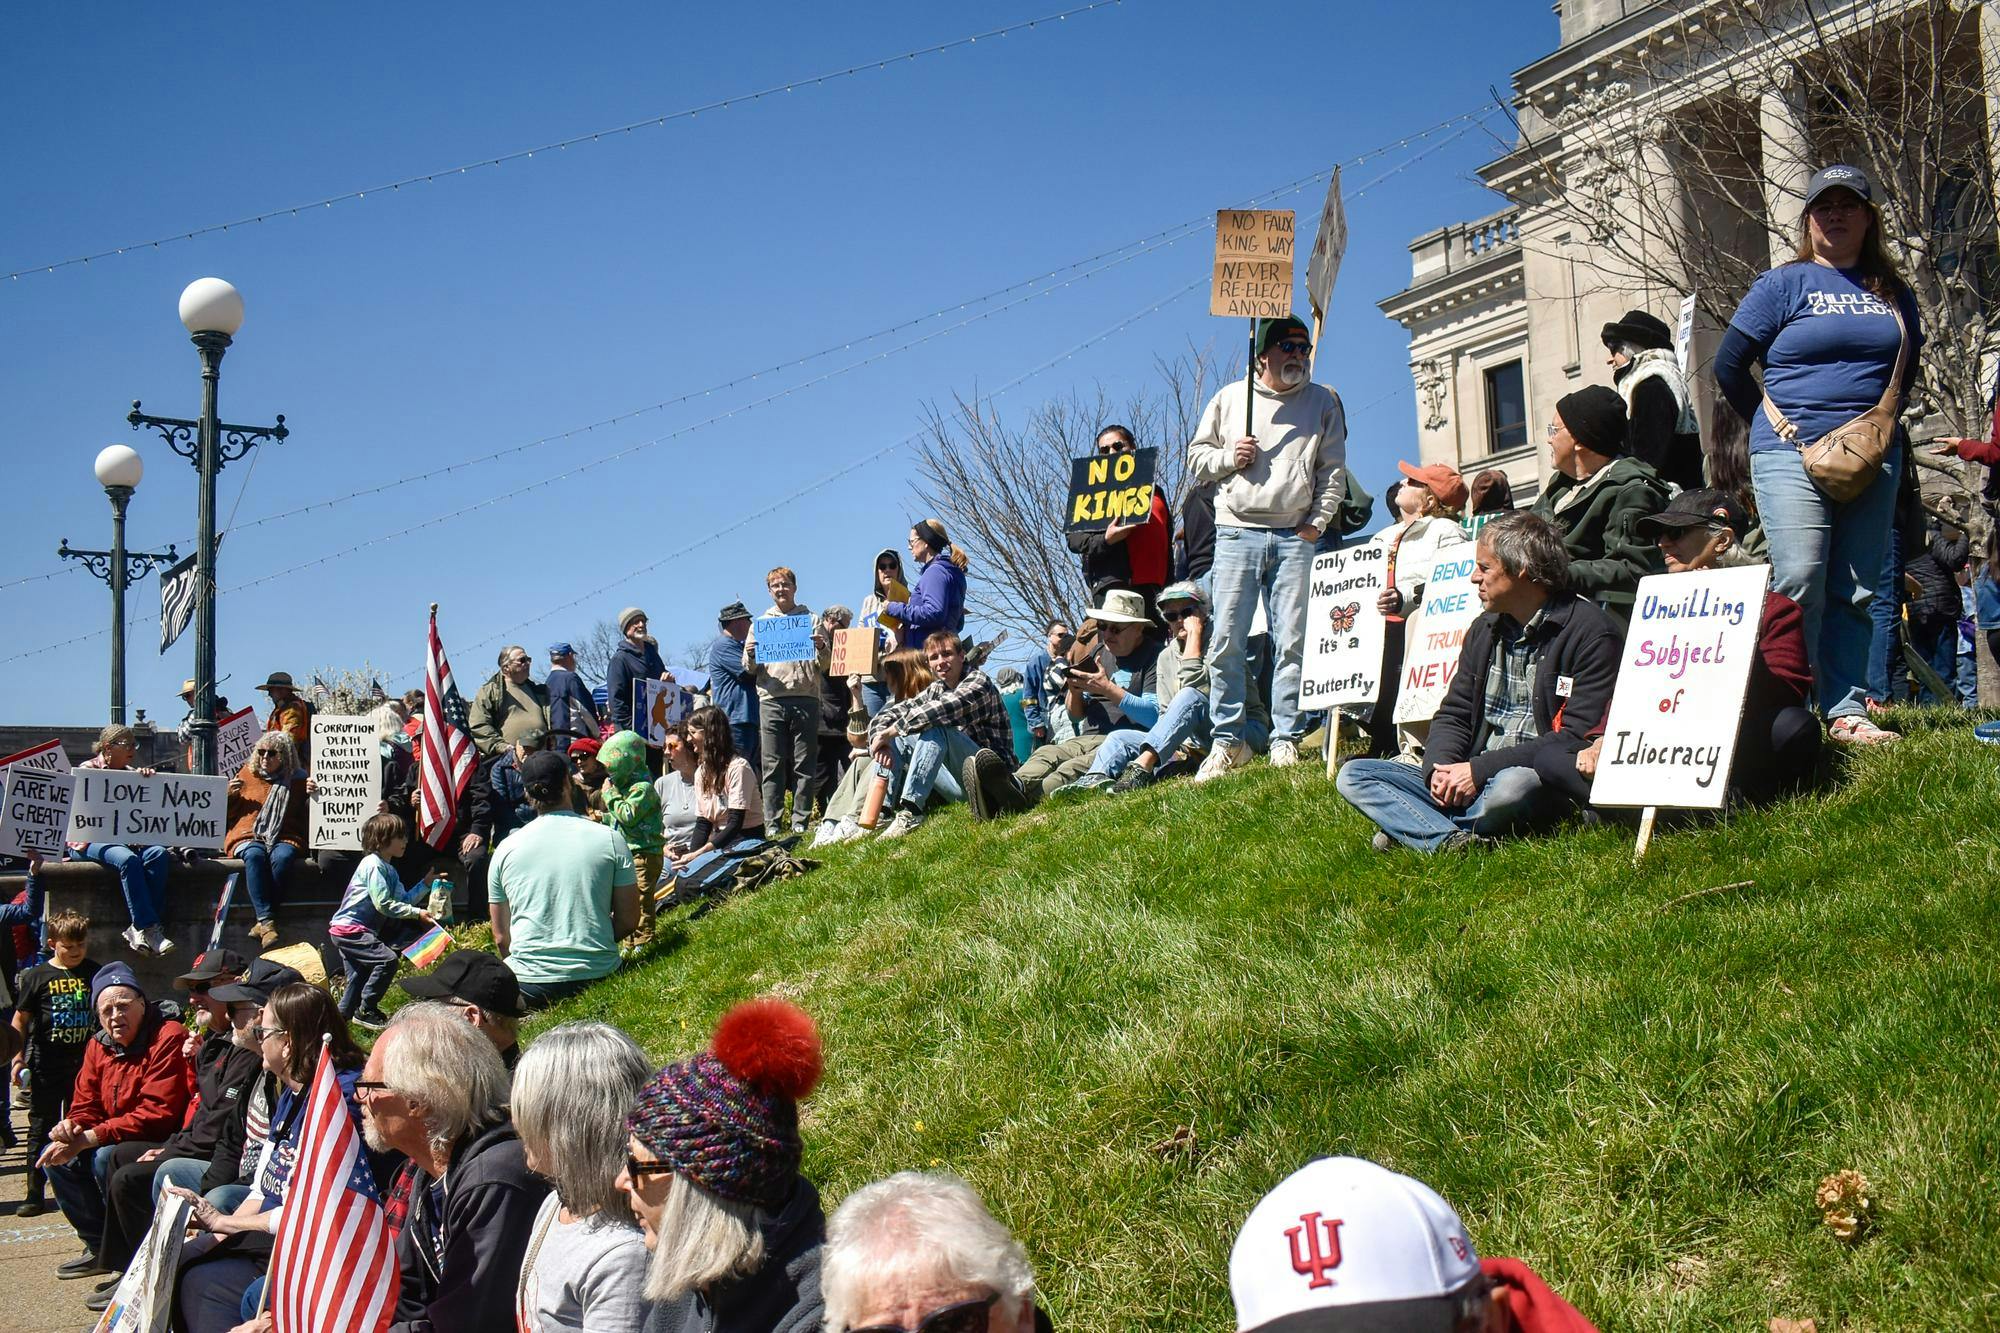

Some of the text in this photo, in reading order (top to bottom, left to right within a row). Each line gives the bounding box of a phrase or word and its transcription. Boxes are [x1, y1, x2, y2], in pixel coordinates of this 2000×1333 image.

[1232, 212, 1293, 232] NO FAUX
[1223, 234, 1294, 256] KING WAY
[1221, 262, 1279, 281] NEVER
[1219, 280, 1292, 300] RE-ELECT
[1807, 291, 1884, 304] CHILDLES
[1228, 299, 1289, 318] ANYONE
[1812, 304, 1846, 315] CAT
[1088, 454, 1135, 486] NO
[1073, 485, 1152, 523] KINGS
[1314, 548, 1382, 573] only one
[1431, 559, 1474, 583] BEND
[1310, 573, 1381, 599] Monarch,
[1425, 593, 1469, 617] KNEE
[780, 617, 808, 630] SINCE
[834, 631, 847, 646] NO
[1319, 637, 1360, 654] it's a
[833, 647, 846, 661] NO
[1634, 631, 1725, 679] Subject
[831, 662, 845, 675] NO
[1406, 660, 1458, 690] NEV
[1302, 672, 1375, 697] Butterfly
[1659, 688, 1684, 713] of
[217, 721, 250, 744] ERICA'S
[314, 722, 375, 734] CORRUPTION
[223, 732, 252, 758] ATE
[326, 735, 361, 745] DEATH
[321, 748, 367, 758] CRUELTY
[1610, 731, 1721, 788] Idiocracy
[316, 759, 371, 770] HARDSHIP
[316, 773, 371, 784] BETRAYAL
[11, 780, 70, 805] ARE WE
[84, 777, 212, 809] I LOVE NAPS
[319, 786, 368, 798] DESPAIR
[12, 803, 66, 826] GREAT
[322, 801, 364, 816] TRUMP
[113, 809, 119, 836] I
[126, 808, 170, 834] STAY
[174, 811, 221, 838] WOKE
[15, 828, 62, 847] YET?!!
